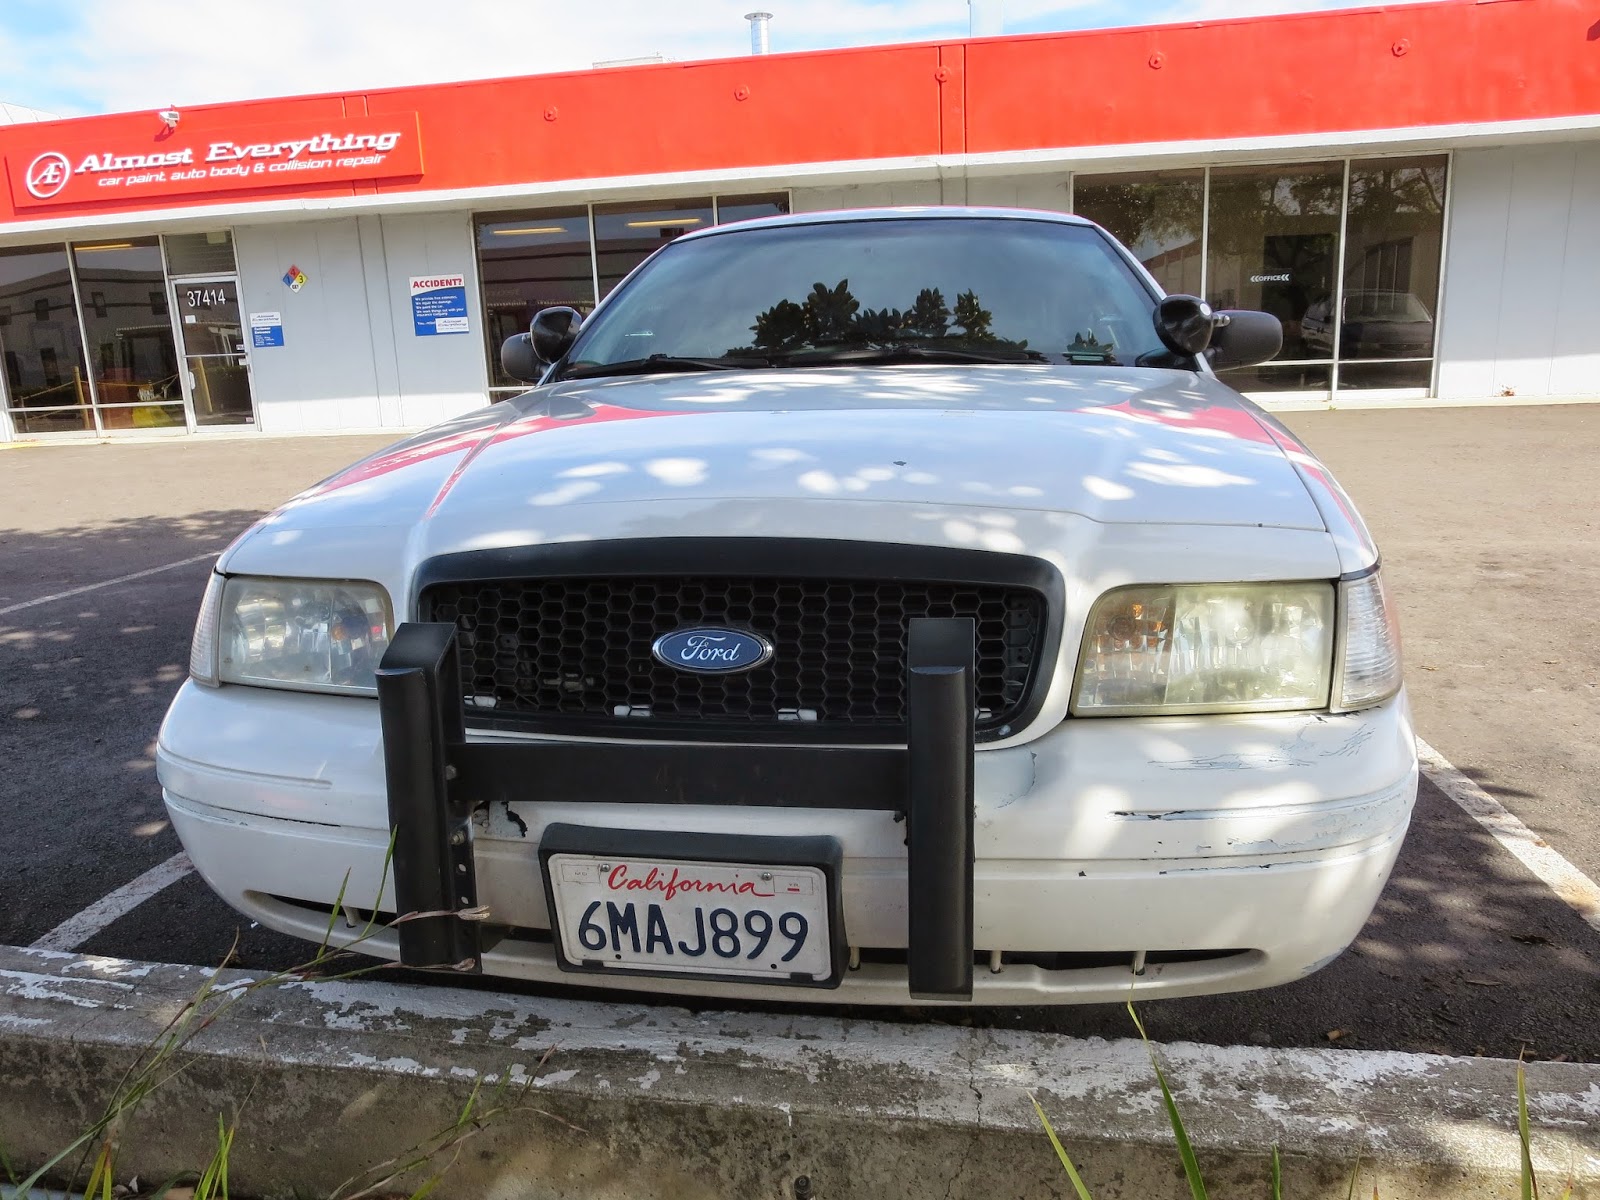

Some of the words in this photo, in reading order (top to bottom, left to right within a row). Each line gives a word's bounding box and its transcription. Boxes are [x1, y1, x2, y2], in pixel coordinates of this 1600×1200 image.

[74, 147, 194, 174] Almost
[205, 132, 401, 161] Everything
[98, 176, 123, 187] car
[170, 168, 206, 181] auto
[210, 163, 250, 178] body
[253, 162, 265, 173] &
[268, 158, 331, 172] collision
[336, 154, 386, 168] repair
[299, 275, 304, 284] 3
[412, 278, 463, 289] ACCIDENT?
[187, 288, 226, 307] 37414
[680, 635, 741, 661] Ford
[608, 864, 775, 901] California
[578, 900, 809, 962] 6MAJ899
